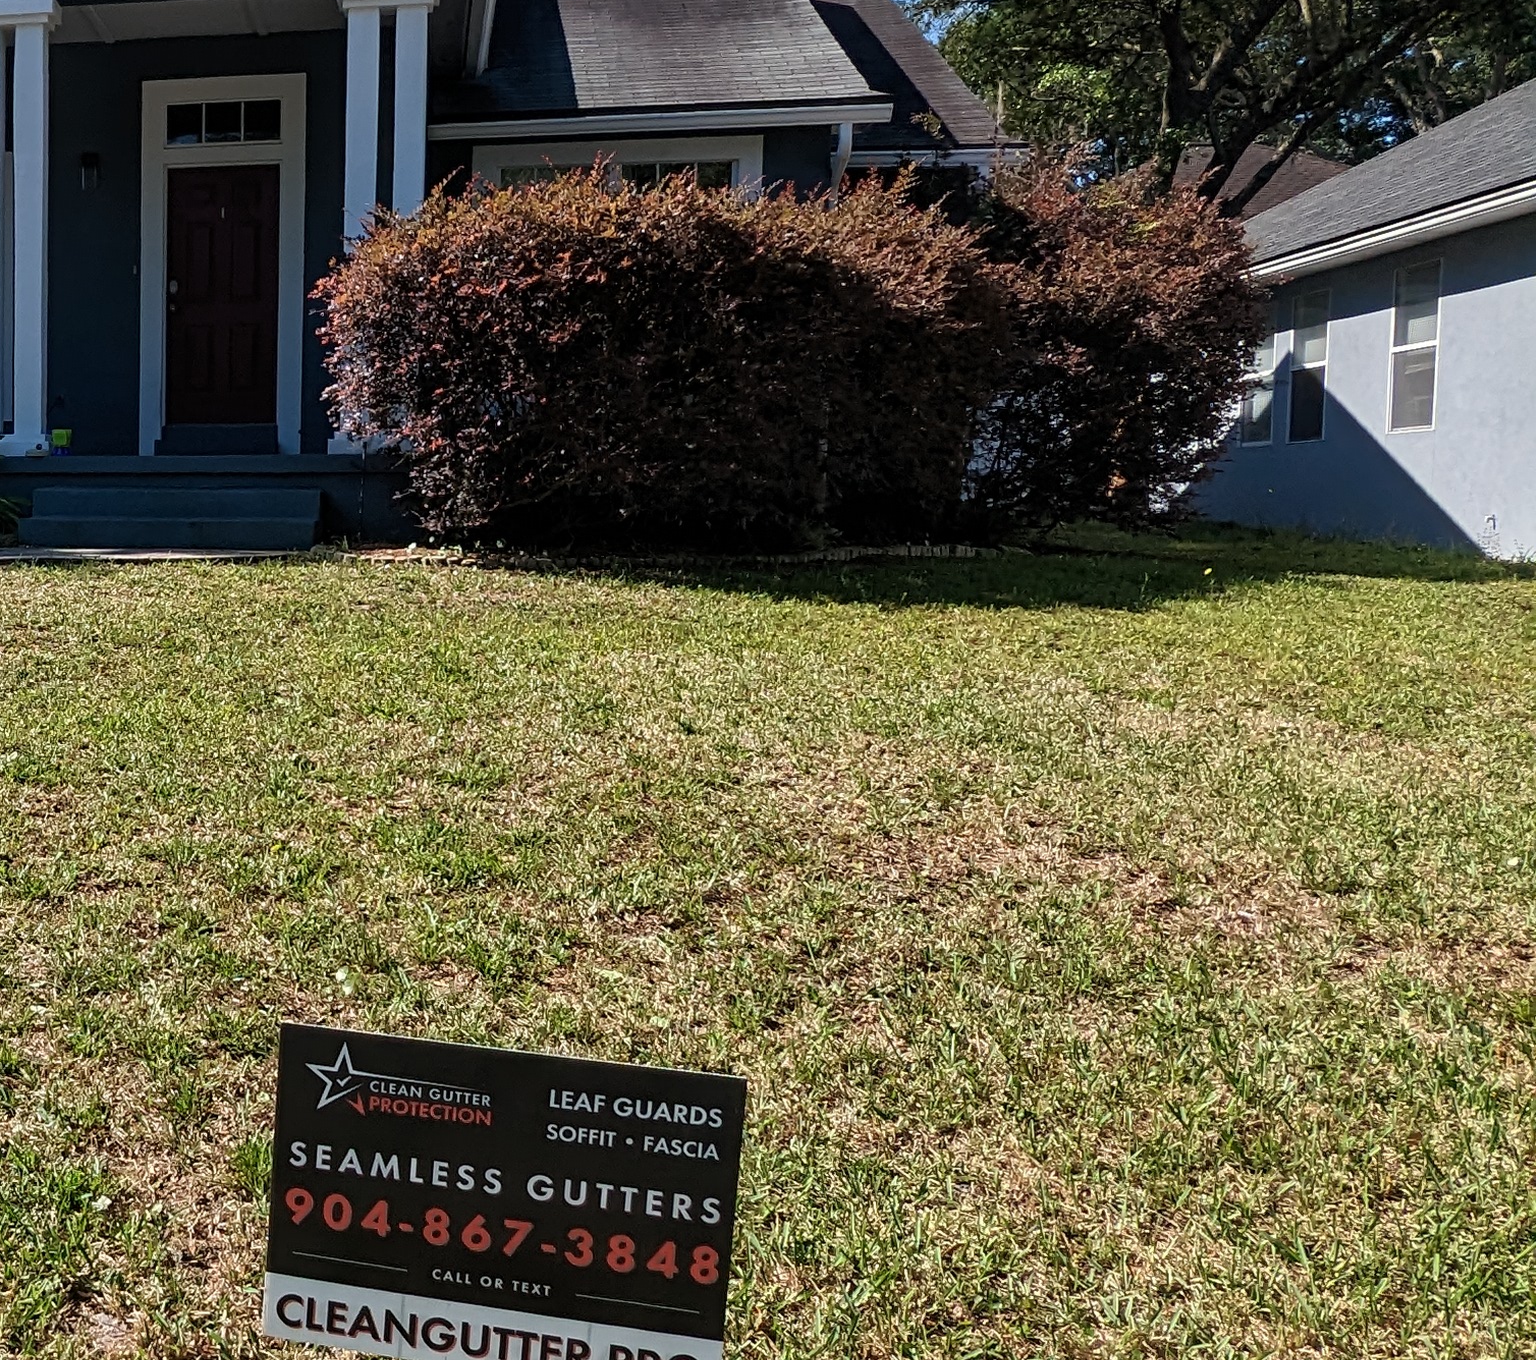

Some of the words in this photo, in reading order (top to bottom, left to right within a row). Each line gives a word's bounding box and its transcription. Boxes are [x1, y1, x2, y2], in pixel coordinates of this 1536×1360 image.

[369, 1096, 491, 1126] PROTECTION
[370, 1080, 423, 1097] CLEAN
[429, 1088, 491, 1107] GUTTER
[549, 1089, 605, 1113] LEAF
[613, 1097, 723, 1128] GUARDS
[547, 1123, 616, 1147] SOFFIT
[643, 1136, 719, 1160] FASCIA
[289, 1141, 503, 1194] SEAMLESS
[527, 1174, 721, 1224] GUTTERS
[285, 1188, 719, 1284] 904-867-3848
[432, 1268, 471, 1286] CALL
[480, 1276, 503, 1289] OR
[512, 1280, 551, 1297] TEXT
